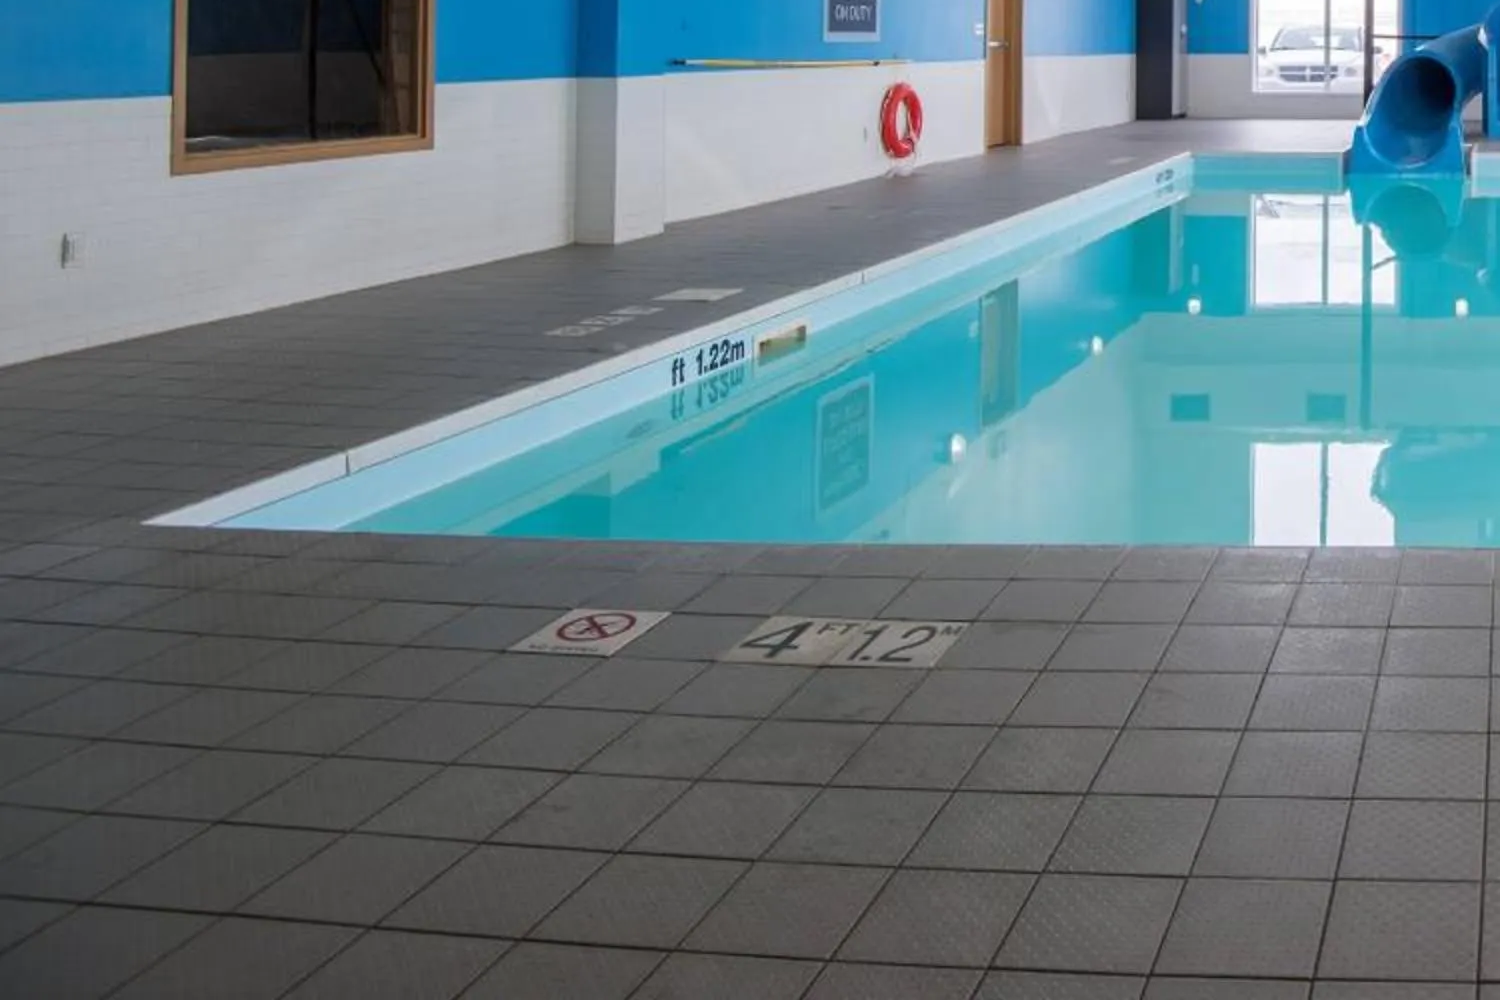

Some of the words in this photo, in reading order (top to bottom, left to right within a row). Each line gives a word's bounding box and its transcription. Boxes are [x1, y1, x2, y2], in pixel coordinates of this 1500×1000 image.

[835, 3, 848, 21] ON
[850, 4, 873, 21] DUTY
[696, 339, 745, 376] 1.22m
